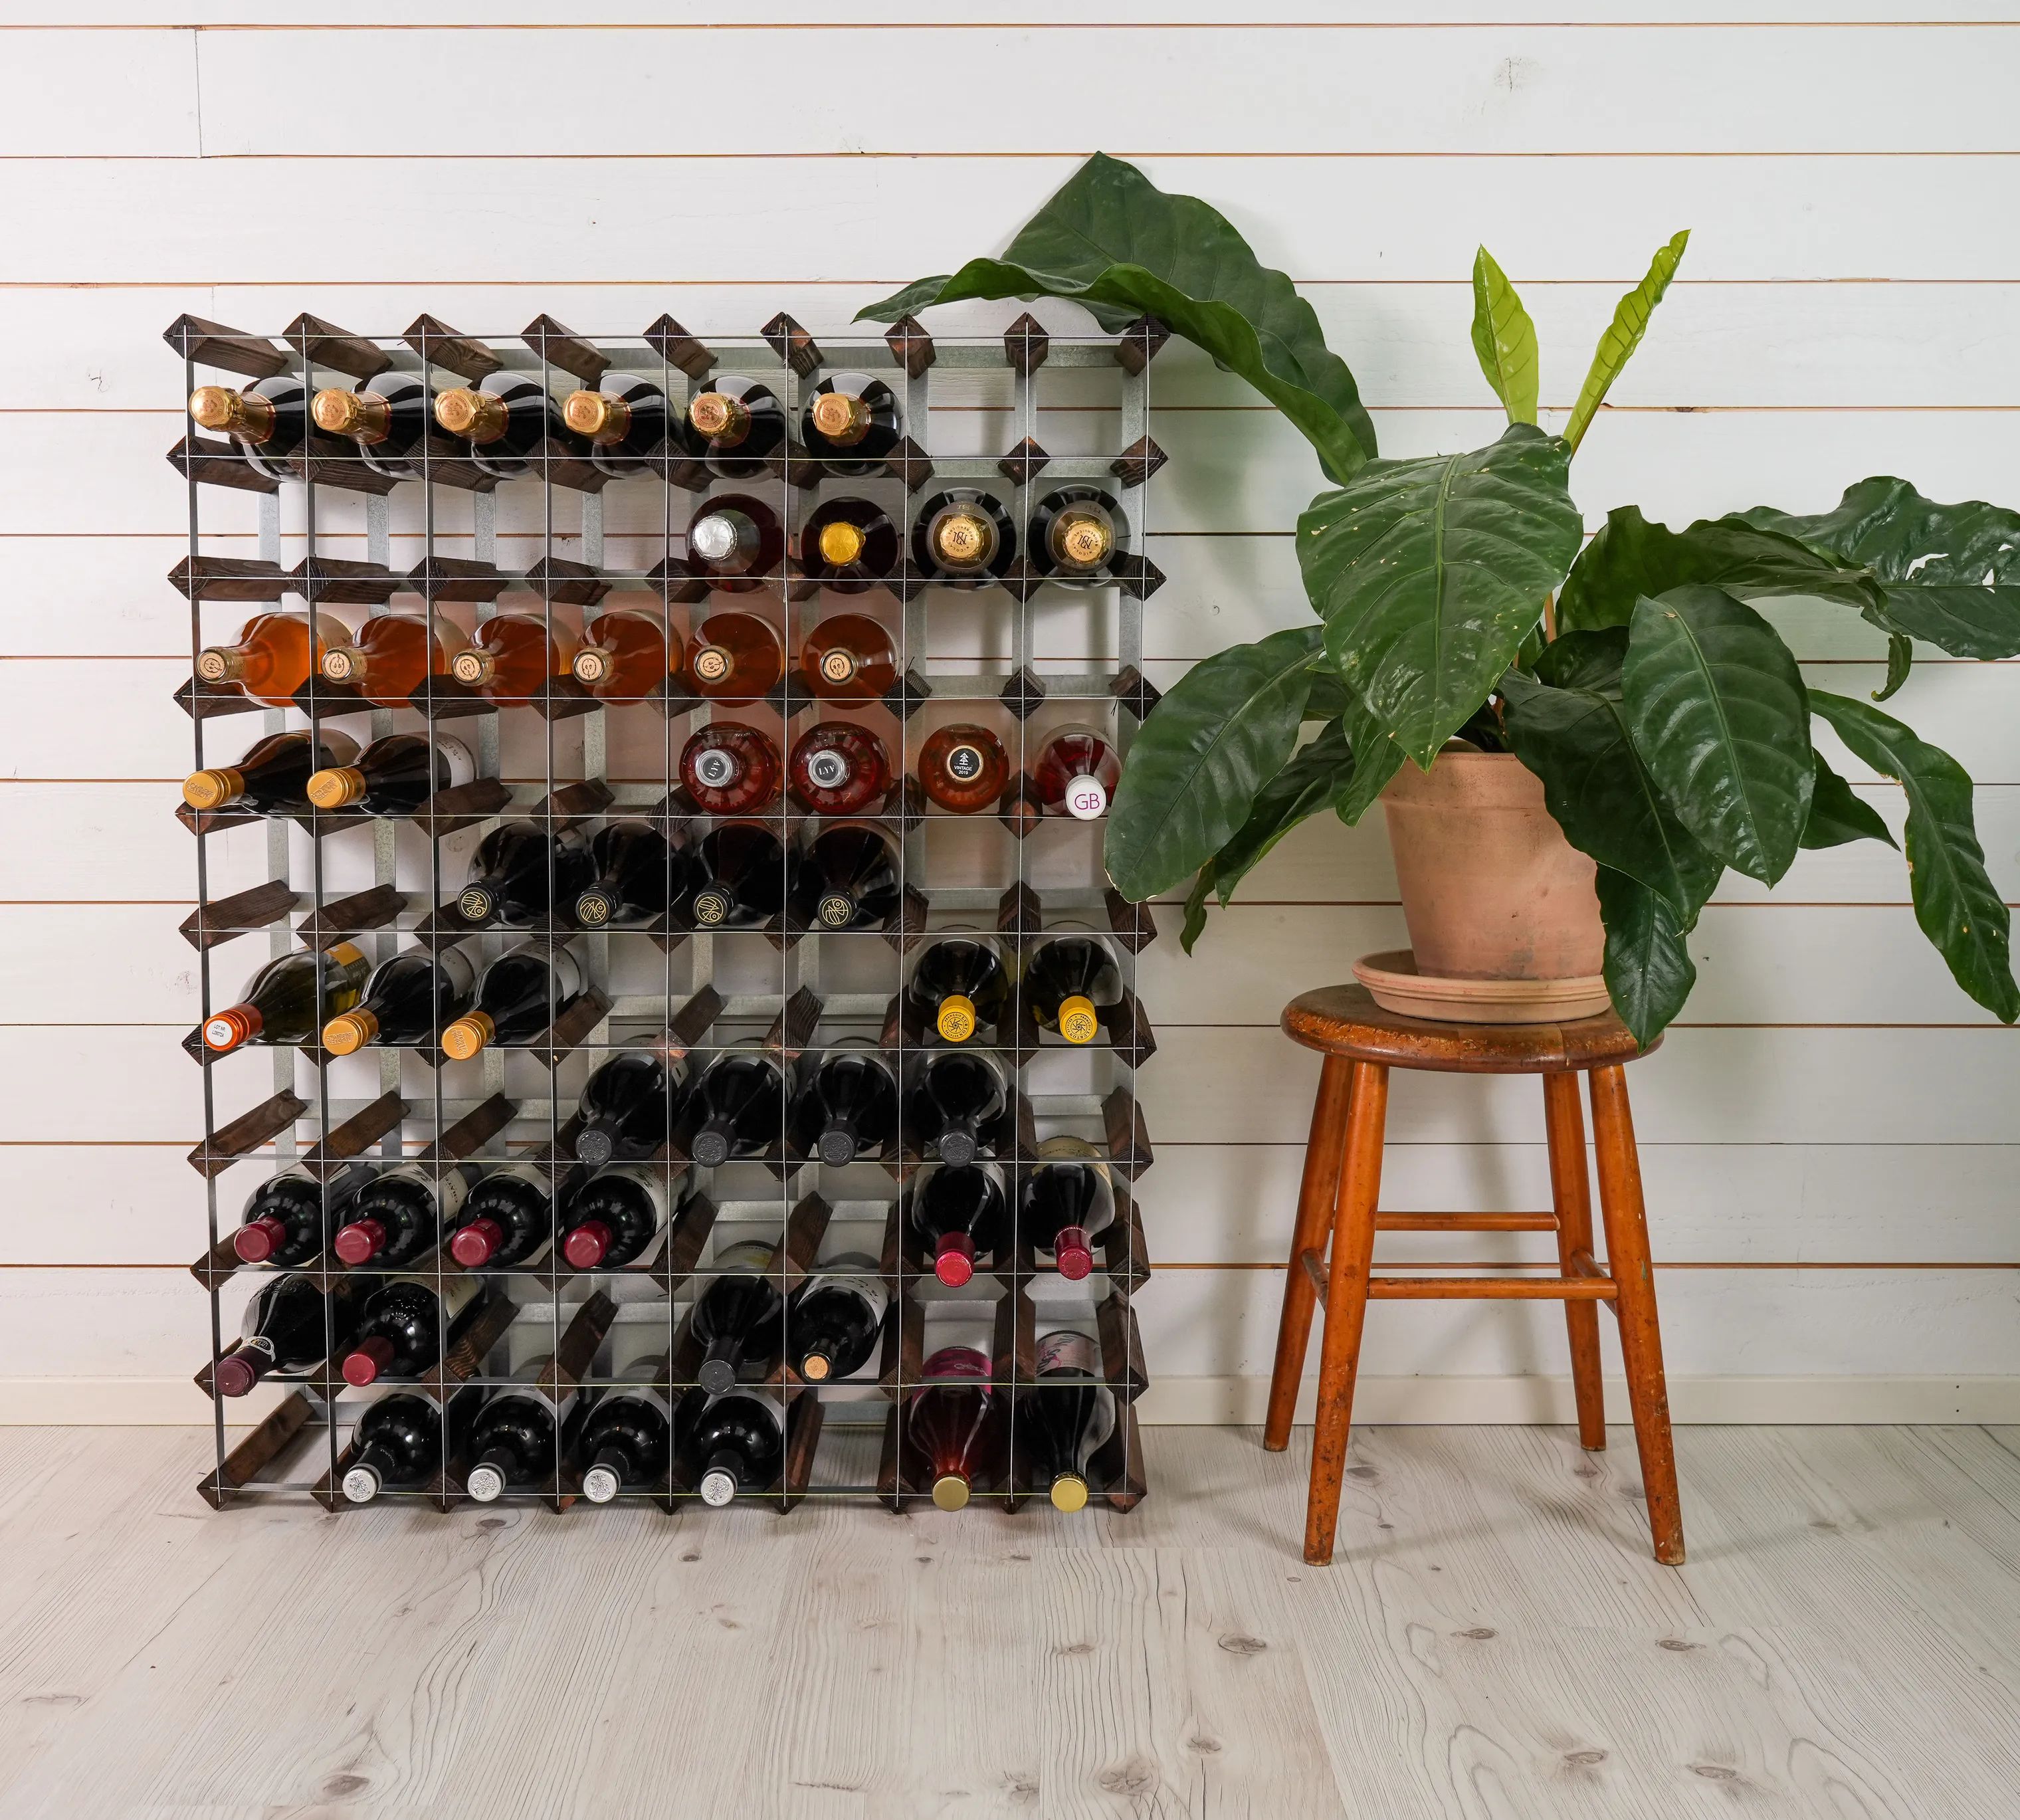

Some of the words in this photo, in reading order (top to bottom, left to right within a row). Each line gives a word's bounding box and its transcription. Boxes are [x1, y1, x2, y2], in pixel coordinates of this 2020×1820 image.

[948, 541, 969, 552] NICOLAS
[1072, 543, 1092, 556] NICOLAS
[1074, 793, 1100, 810] GB
[960, 1016, 968, 1036] LURTON
